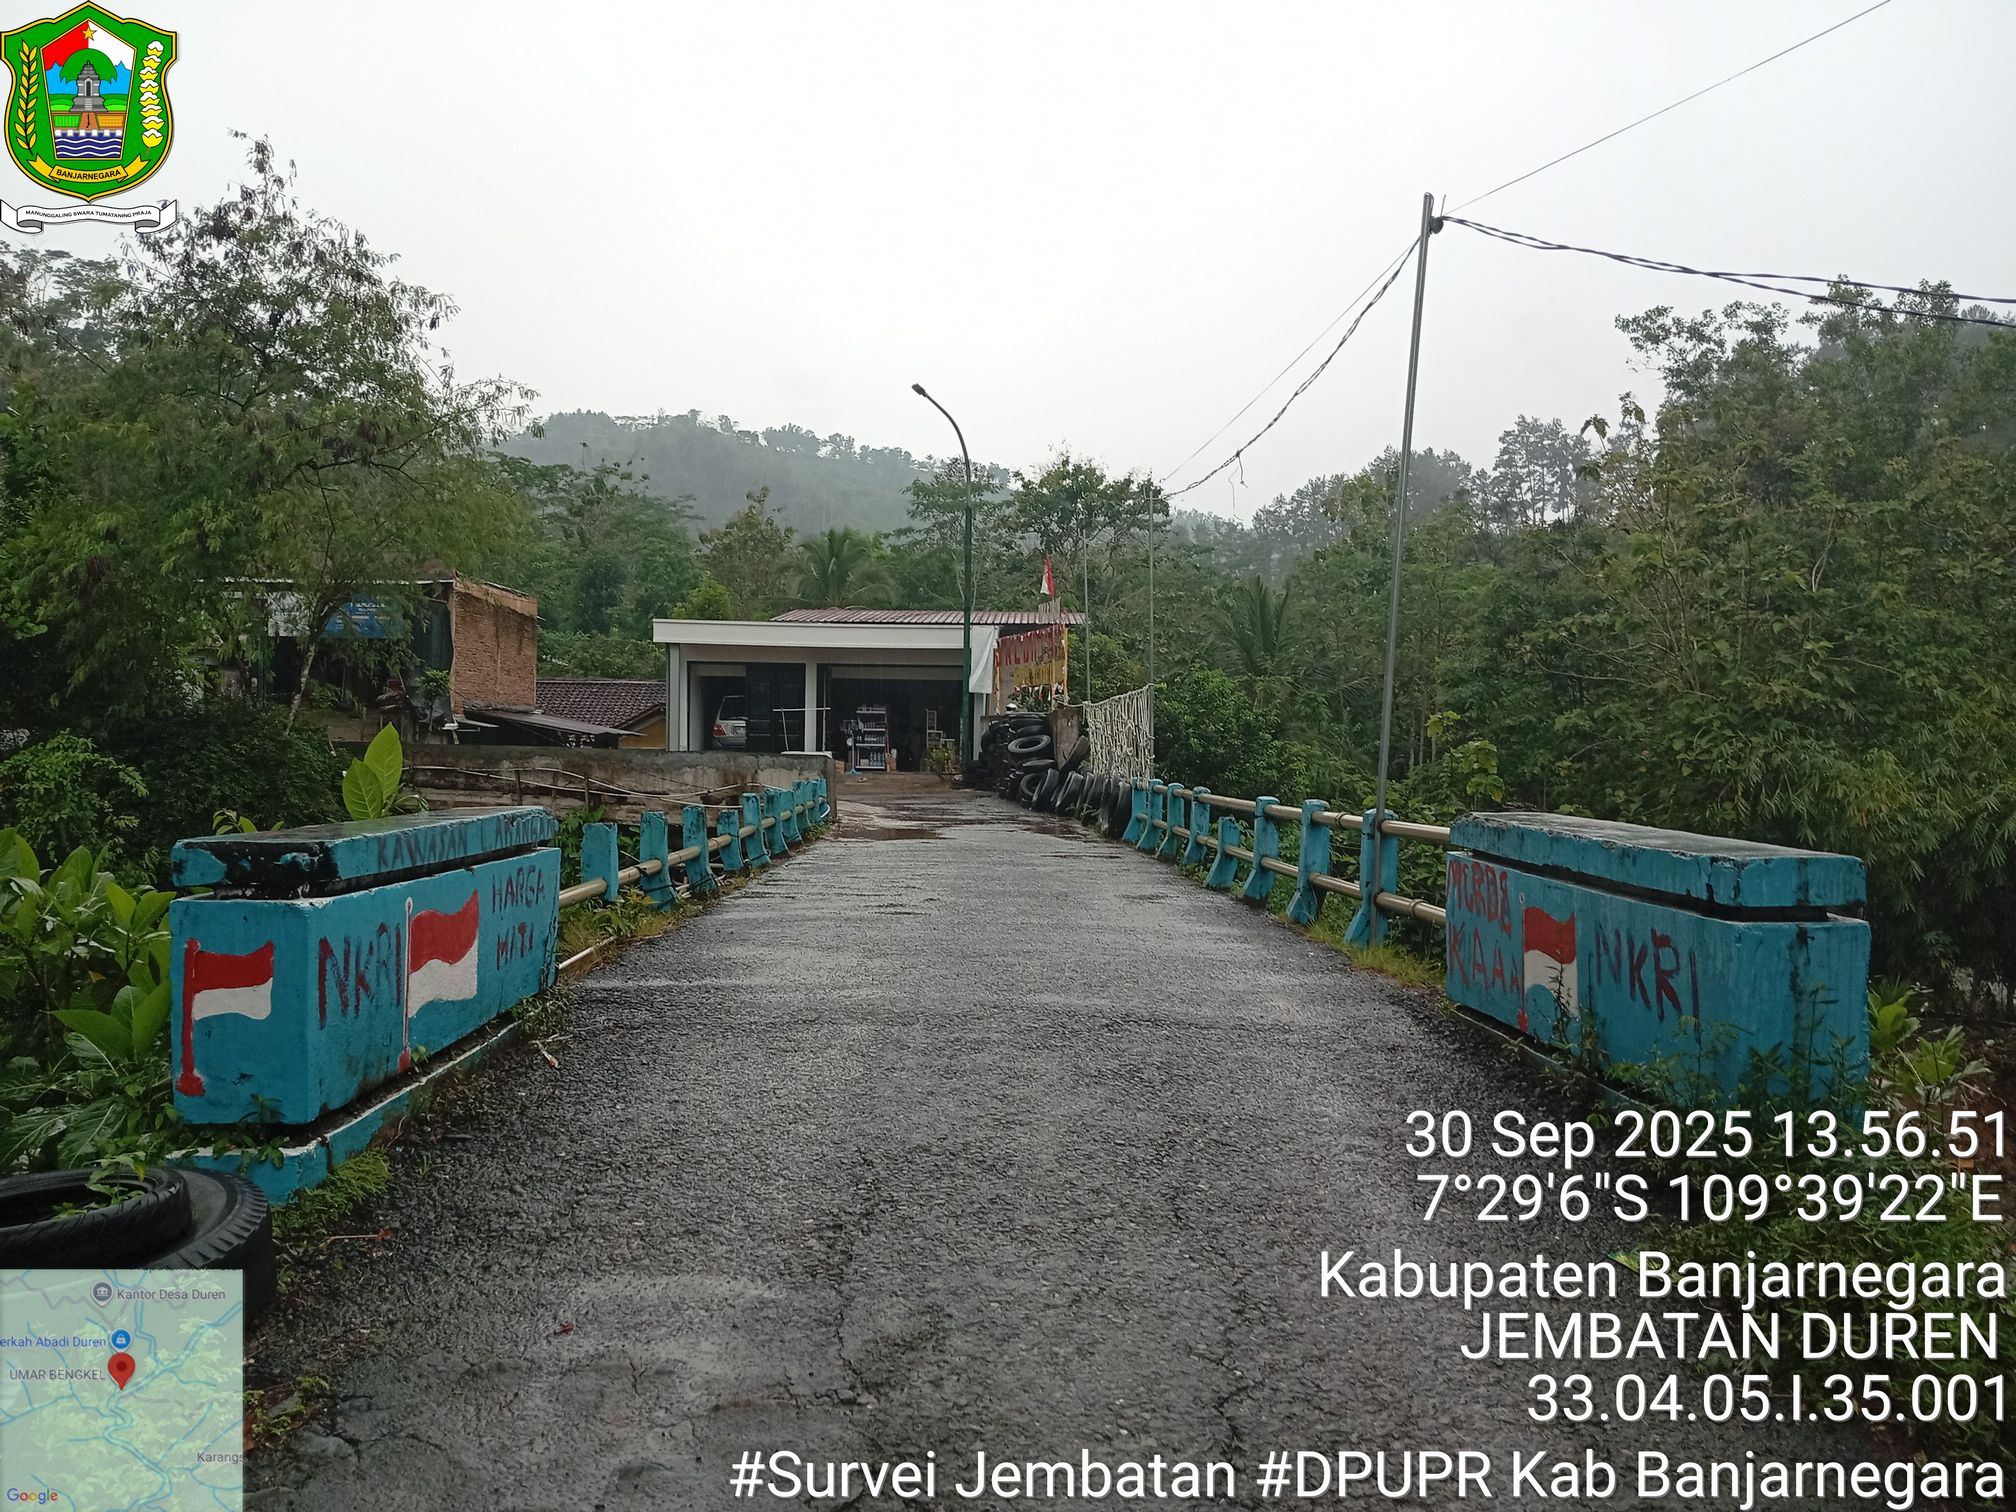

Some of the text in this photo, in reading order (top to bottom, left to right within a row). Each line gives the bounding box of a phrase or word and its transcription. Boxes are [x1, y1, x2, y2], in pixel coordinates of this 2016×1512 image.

[378, 827, 469, 871] KAWASAN
[491, 864, 546, 919] HARGA
[496, 921, 535, 972] MATI
[318, 921, 403, 1030] NKRI
[1594, 922, 1702, 1044] NKRI
